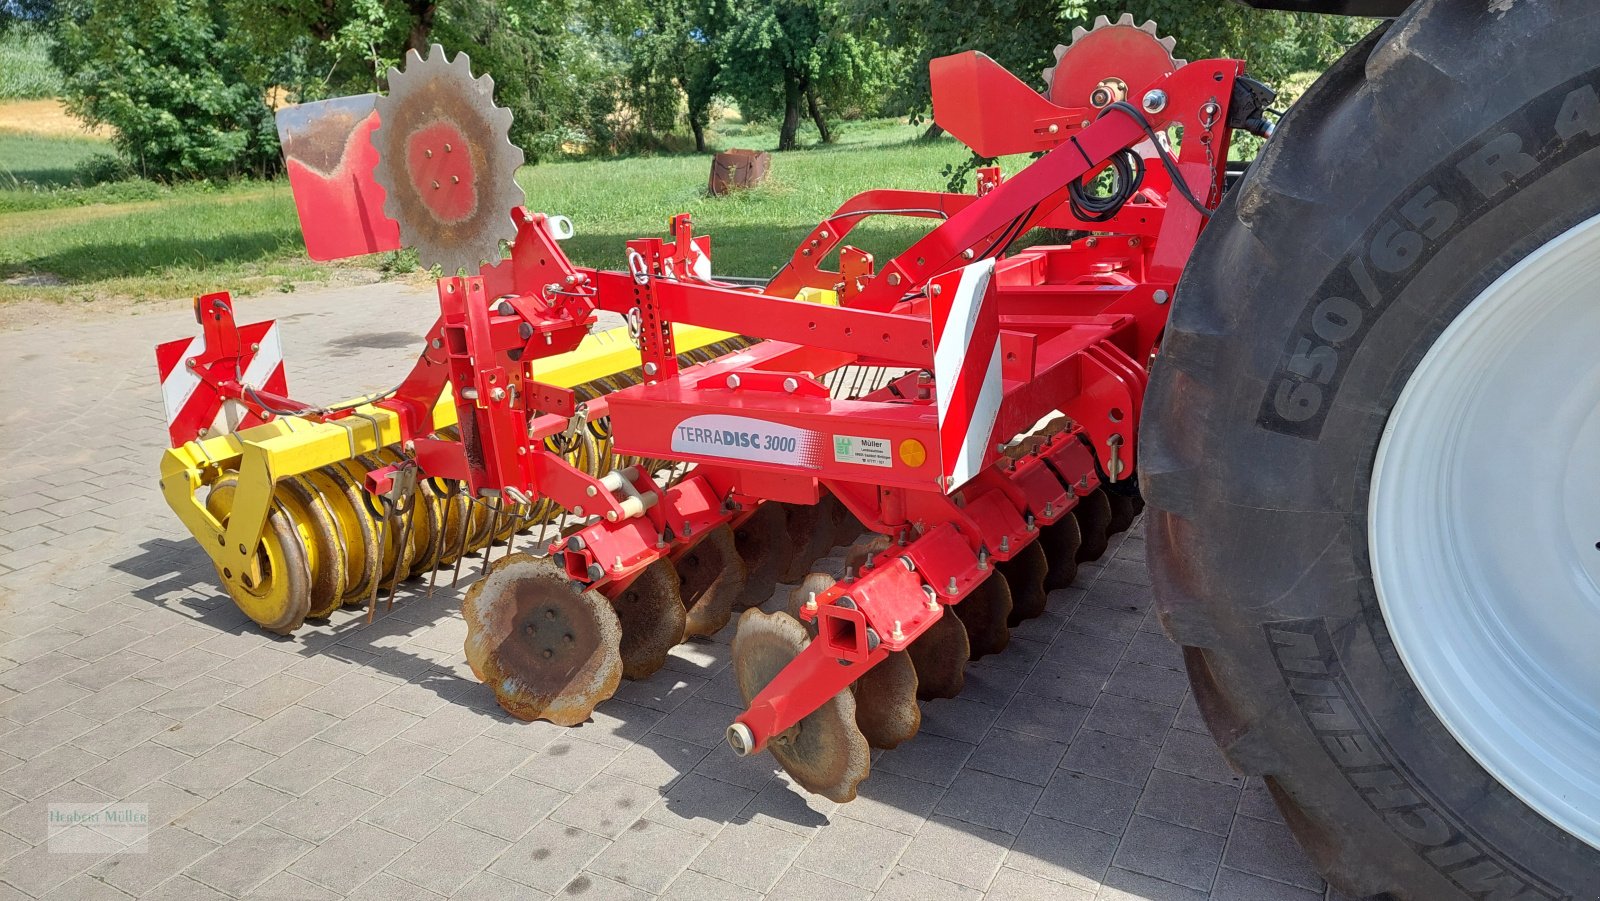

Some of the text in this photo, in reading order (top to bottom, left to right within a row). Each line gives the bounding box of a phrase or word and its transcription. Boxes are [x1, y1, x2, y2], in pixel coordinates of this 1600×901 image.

[1274, 187, 1458, 422] 650/65
[1456, 132, 1541, 198] R
[677, 426, 796, 452] TERRADISC 3000
[861, 439, 883, 448] Müller
[1266, 627, 1549, 901] MICHELIN
